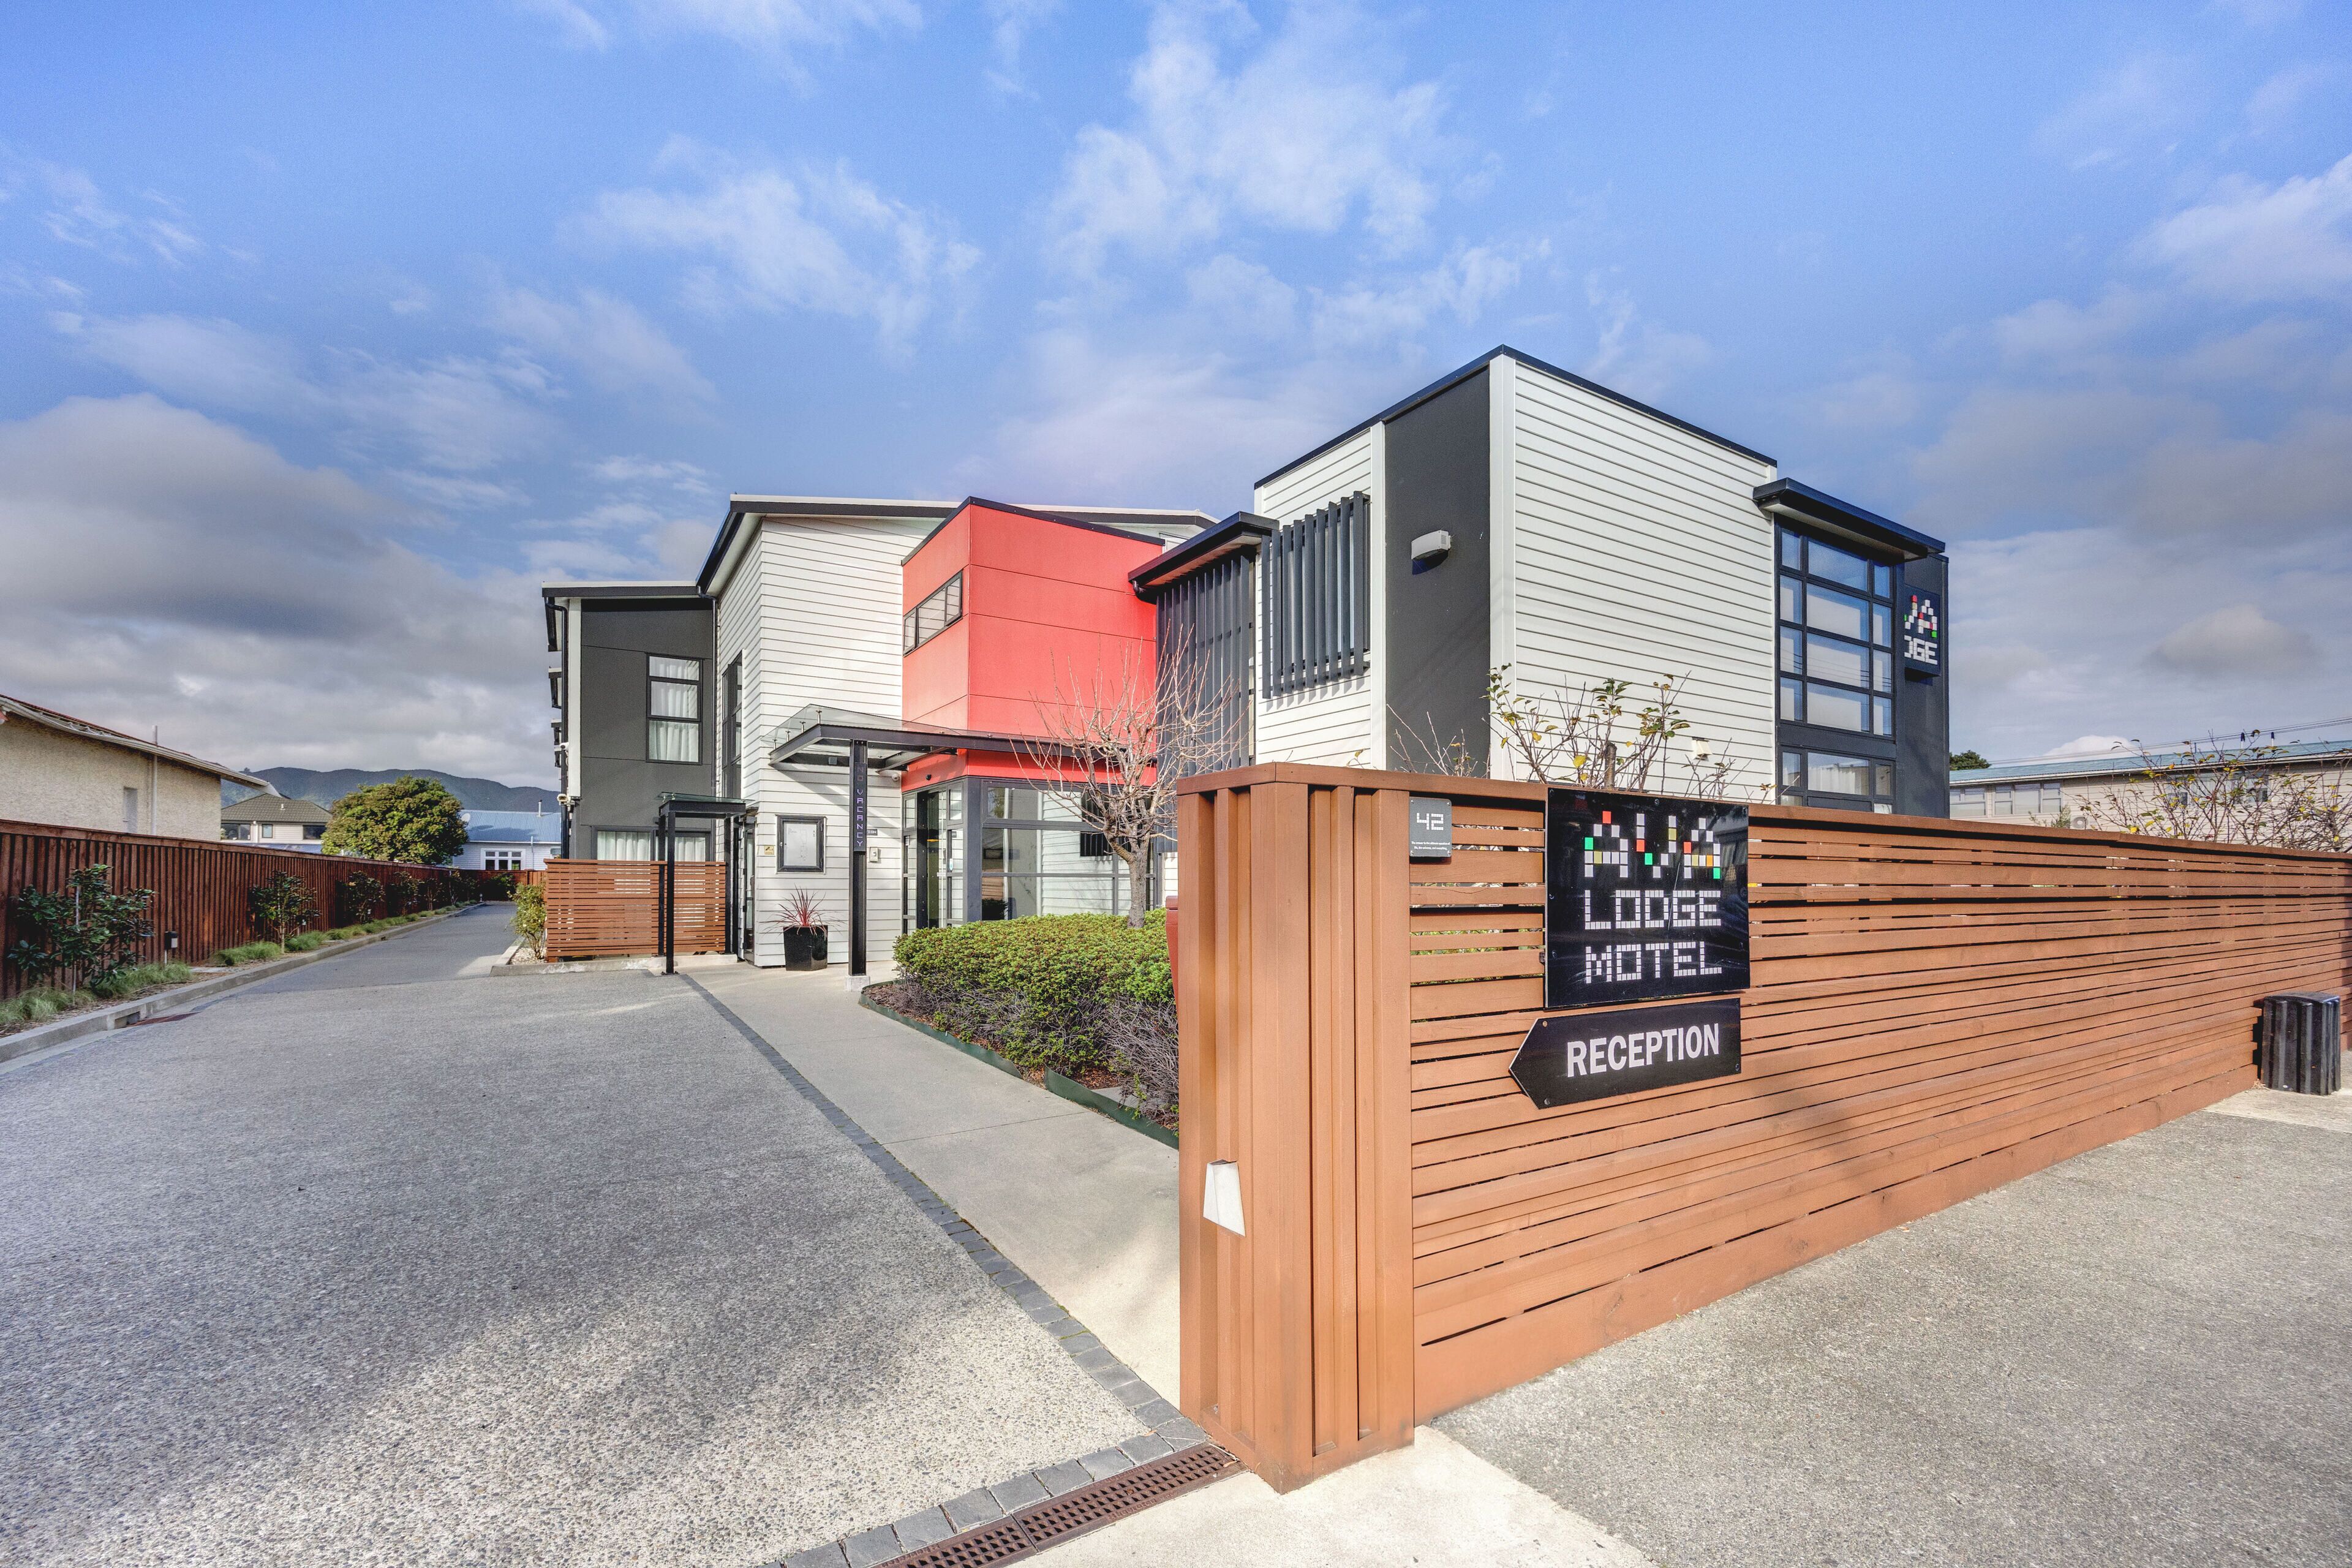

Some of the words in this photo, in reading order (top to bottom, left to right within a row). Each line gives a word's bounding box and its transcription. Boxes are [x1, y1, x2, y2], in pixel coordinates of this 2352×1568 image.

[1416, 812, 1444, 831] 42
[1585, 810, 1721, 880] AVA
[1585, 889, 1722, 930] LODGE
[1585, 941, 1722, 984] MOTEL
[1567, 1022, 1719, 1078] RECEPTION
